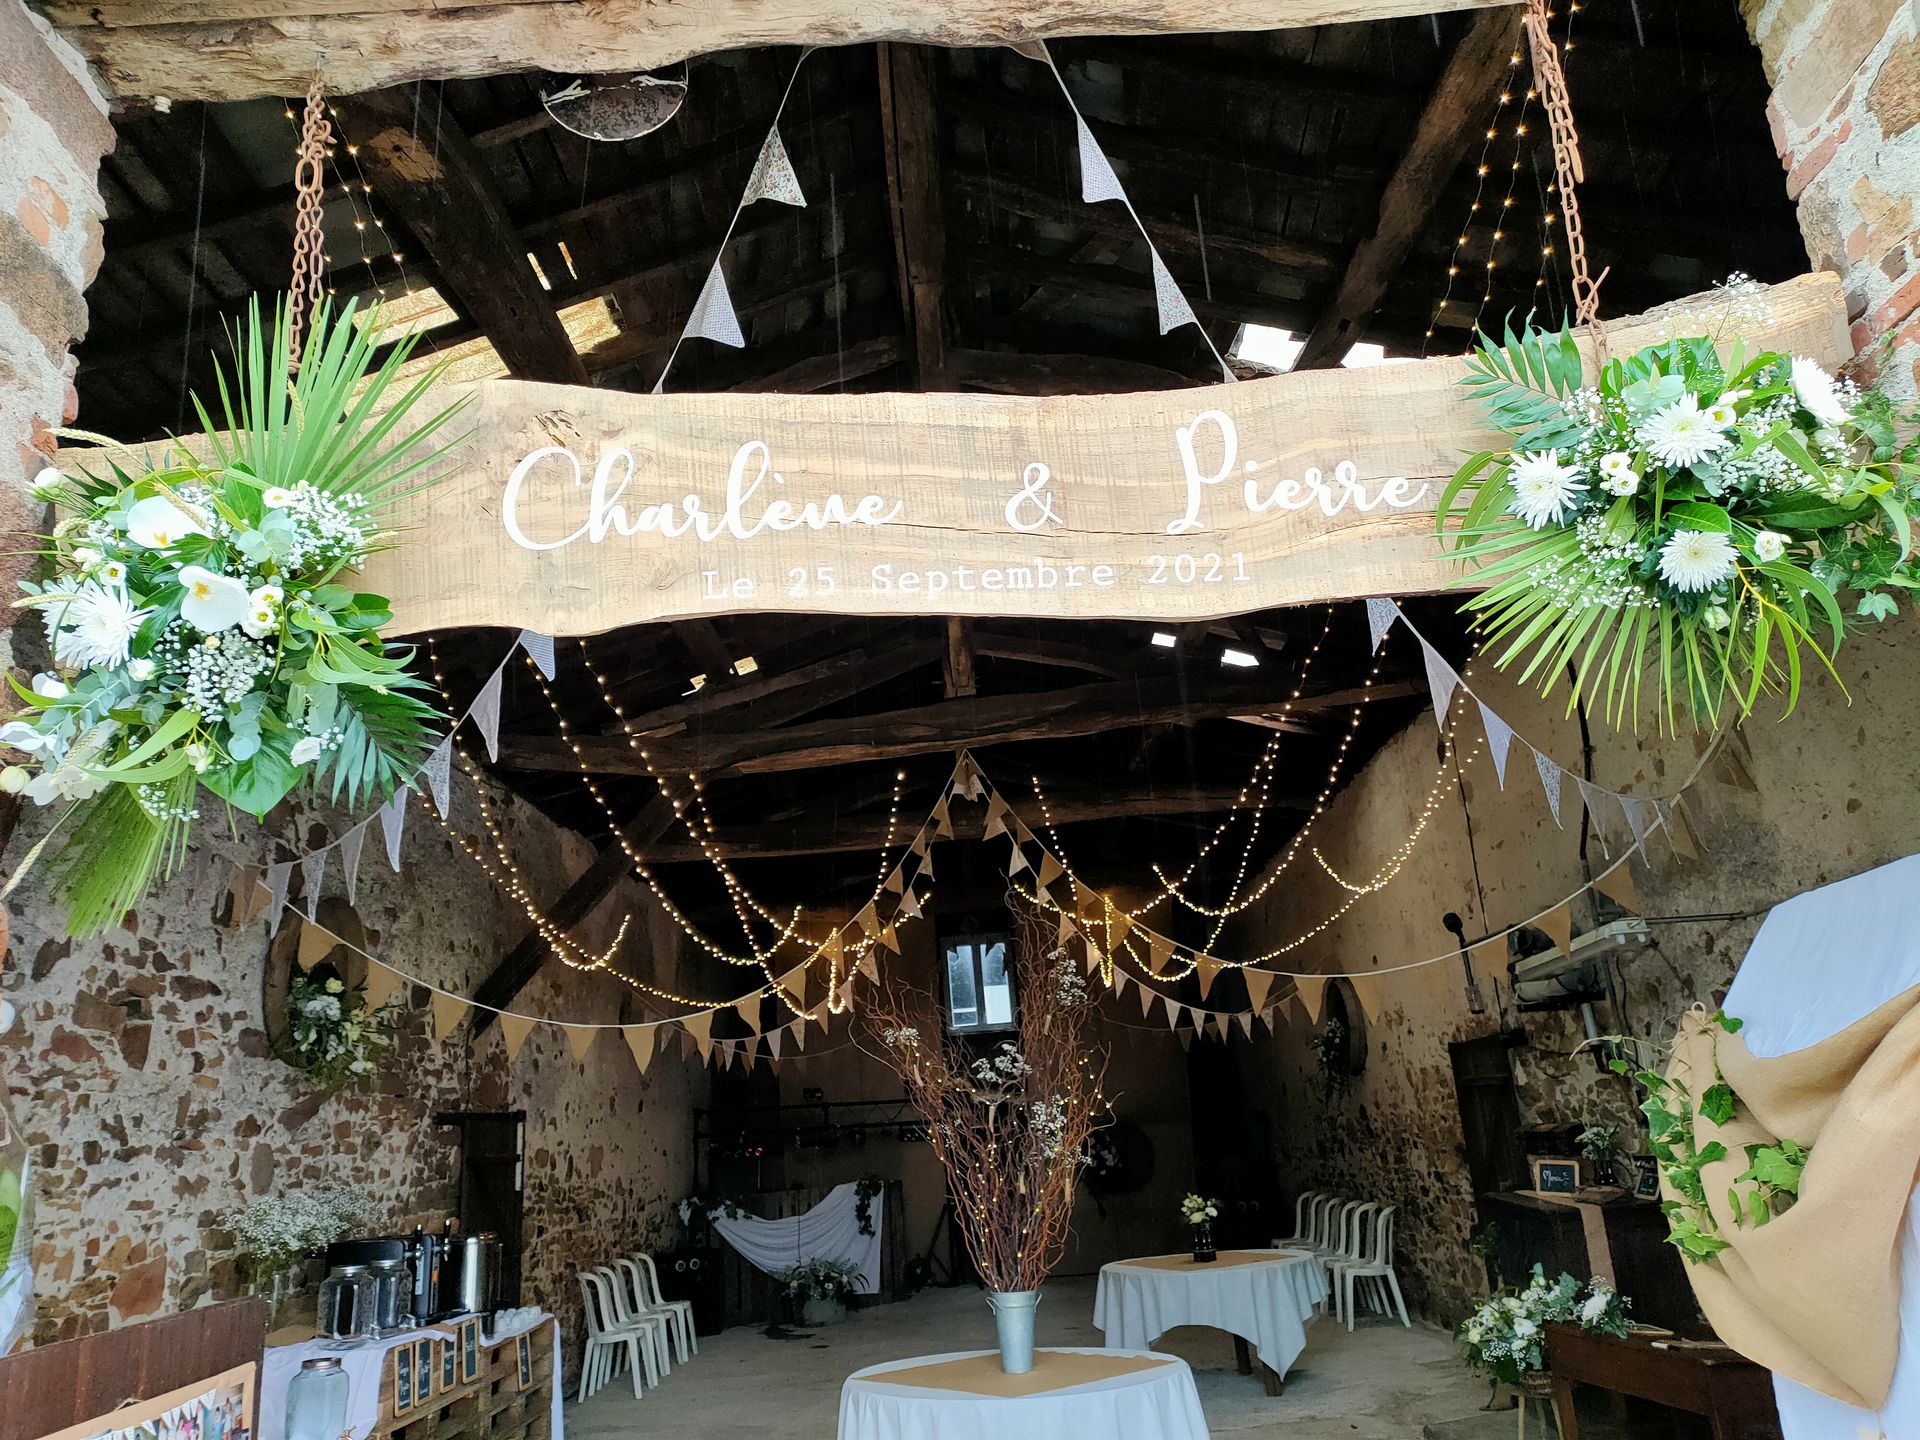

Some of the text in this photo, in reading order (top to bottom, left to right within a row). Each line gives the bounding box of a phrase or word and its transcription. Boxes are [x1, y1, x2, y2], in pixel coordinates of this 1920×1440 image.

[502, 409, 1428, 551] Charlène & Pierre
[702, 552, 1250, 600] Le 25 Septembre 2021
